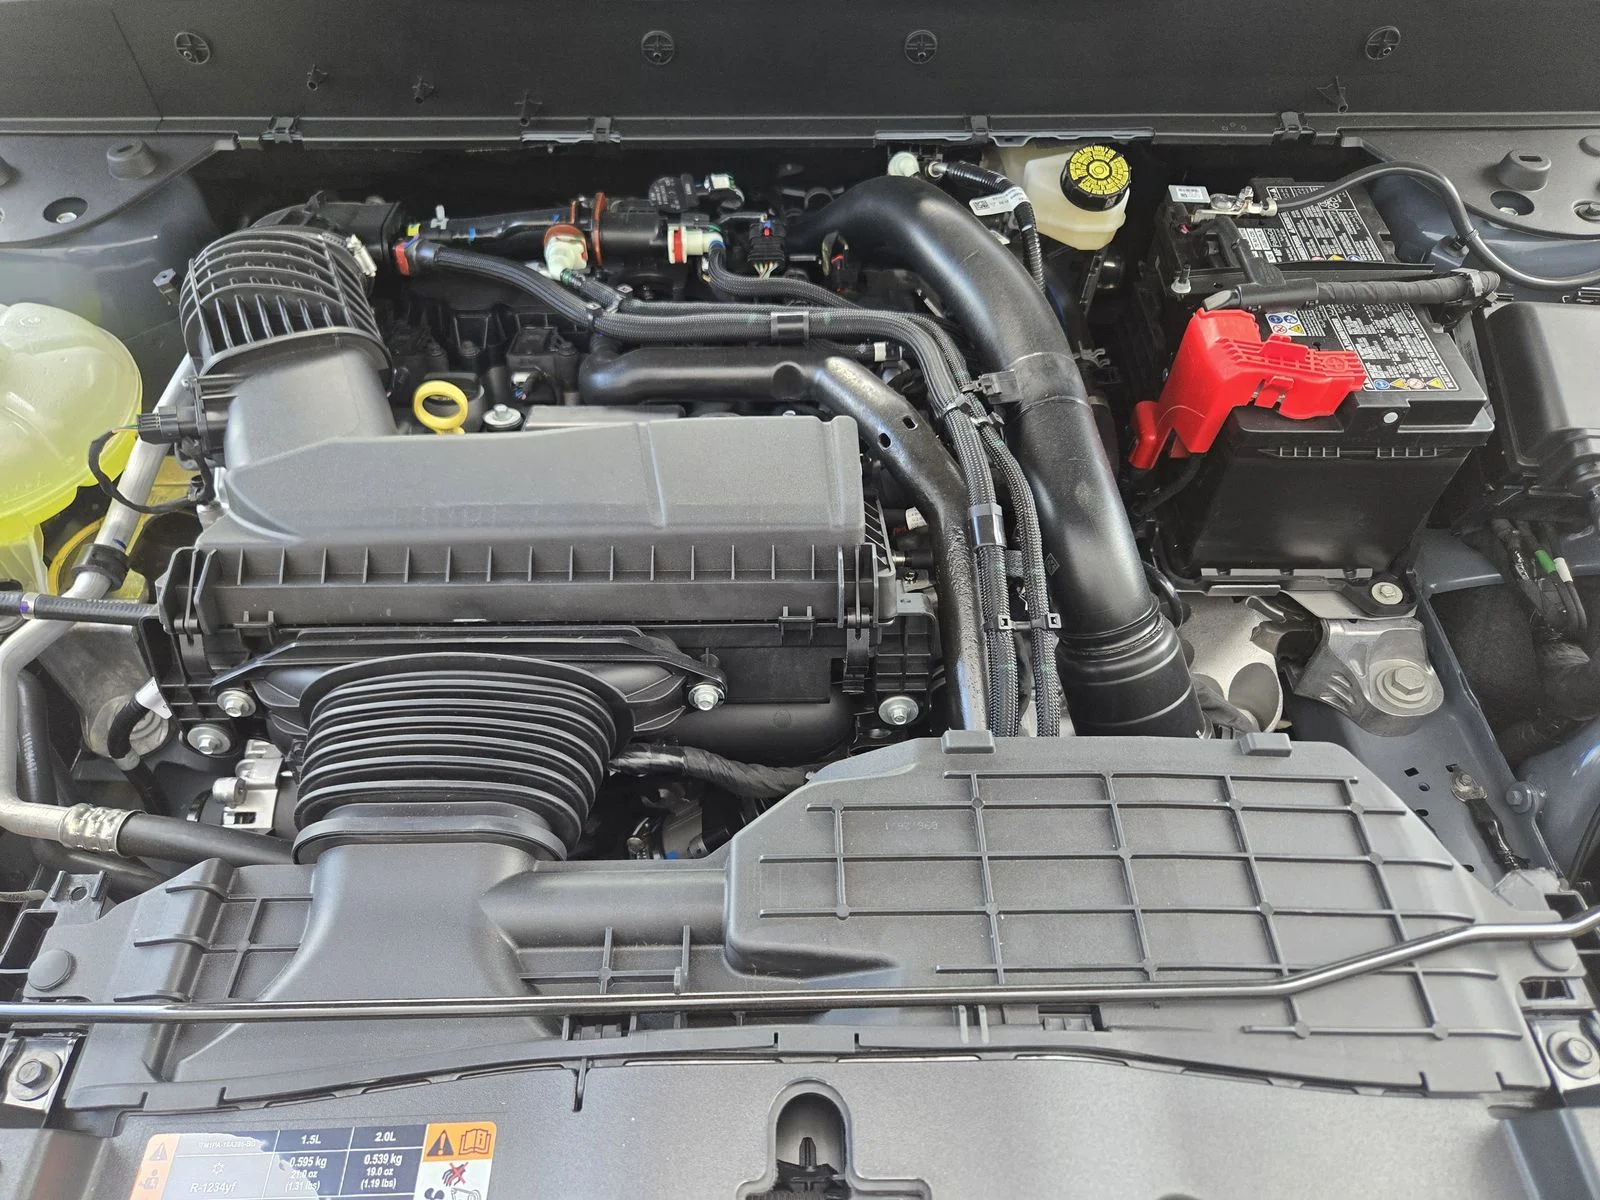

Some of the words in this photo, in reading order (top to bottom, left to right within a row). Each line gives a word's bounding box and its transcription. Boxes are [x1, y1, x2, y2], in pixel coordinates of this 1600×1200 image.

[301, 1134, 322, 1144] 1.5L
[374, 1132, 396, 1142] 2.0L
[289, 1156, 314, 1167] 0.595
[315, 1156, 327, 1169] kg
[364, 1154, 389, 1165] 0.539
[390, 1153, 402, 1166] kg
[308, 1171, 318, 1179] oz
[366, 1168, 383, 1177] 19.0
[360, 1179, 379, 1190] (1.19
[381, 1178, 396, 1189] lbs)
